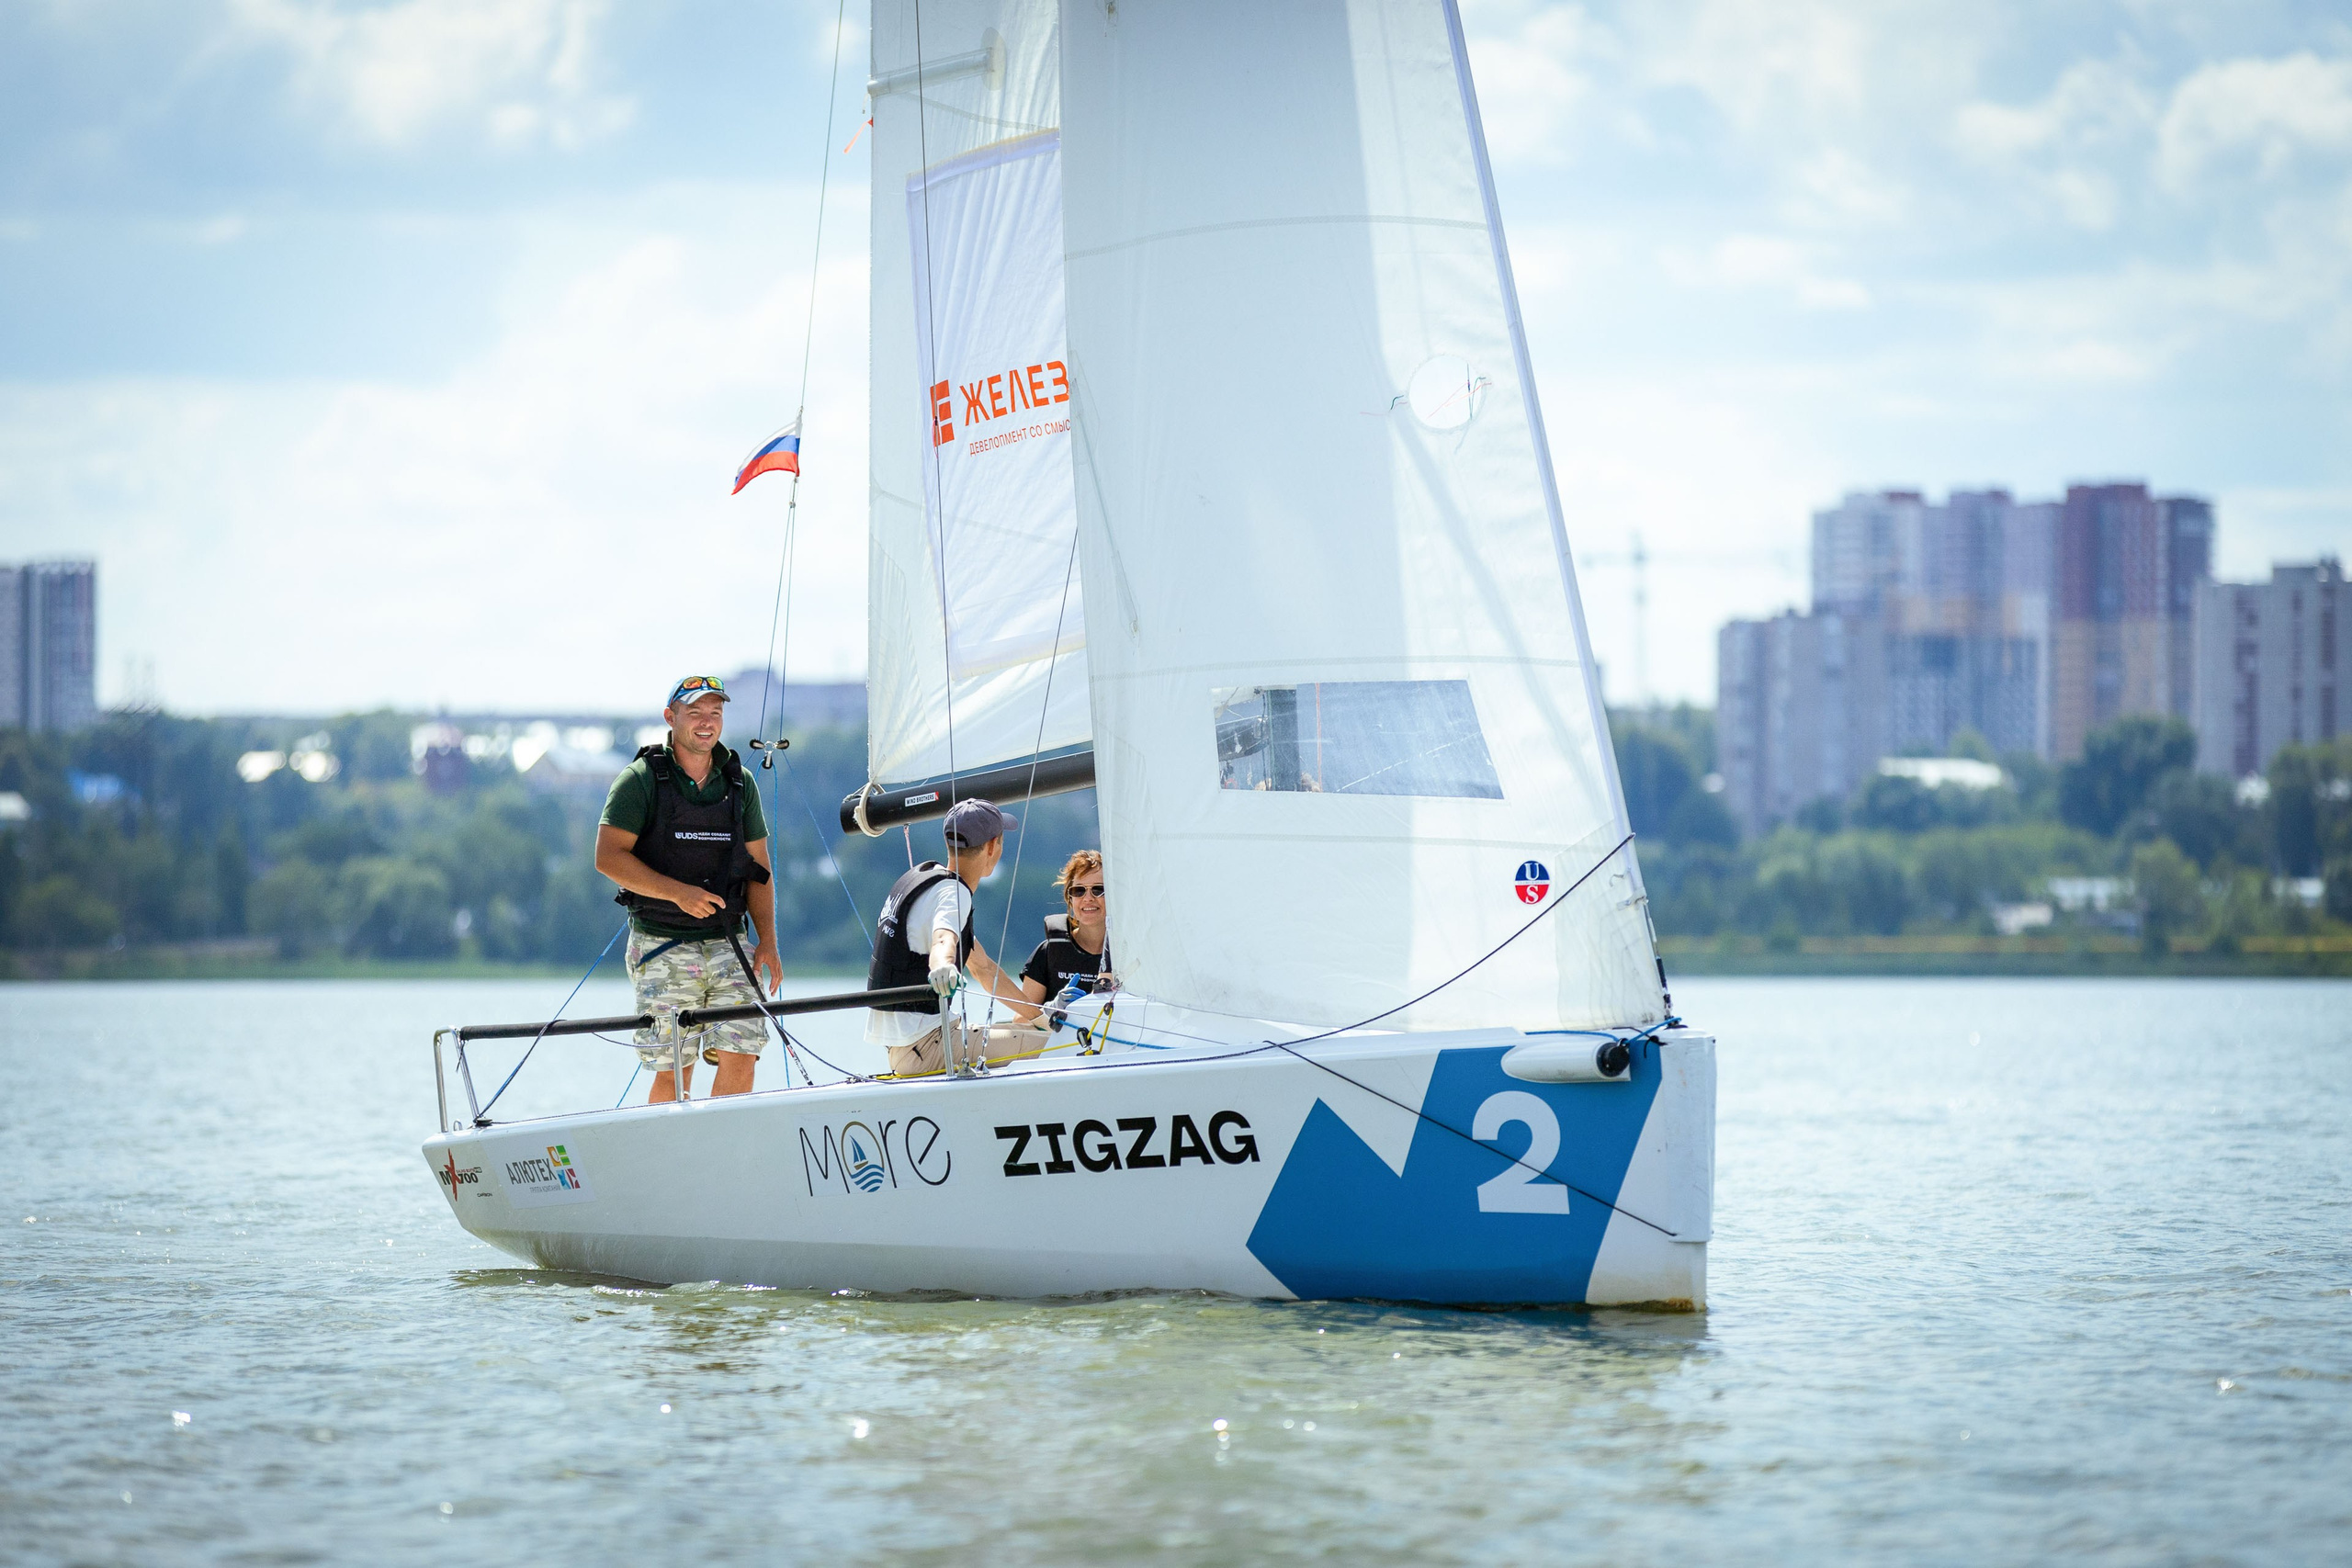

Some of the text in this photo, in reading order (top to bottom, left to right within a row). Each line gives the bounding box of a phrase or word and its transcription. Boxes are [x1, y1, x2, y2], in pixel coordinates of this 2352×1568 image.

[959, 360, 1069, 426] ЖЕЛЕЗ
[969, 427, 1027, 457] ДЕВЕЛОПМЕНТ
[1029, 424, 1043, 438] СО
[505, 1158, 557, 1185] АЛЮТЕХ
[994, 1111, 1261, 1177] ZIGZAG
[1472, 1090, 1570, 1214] 2
